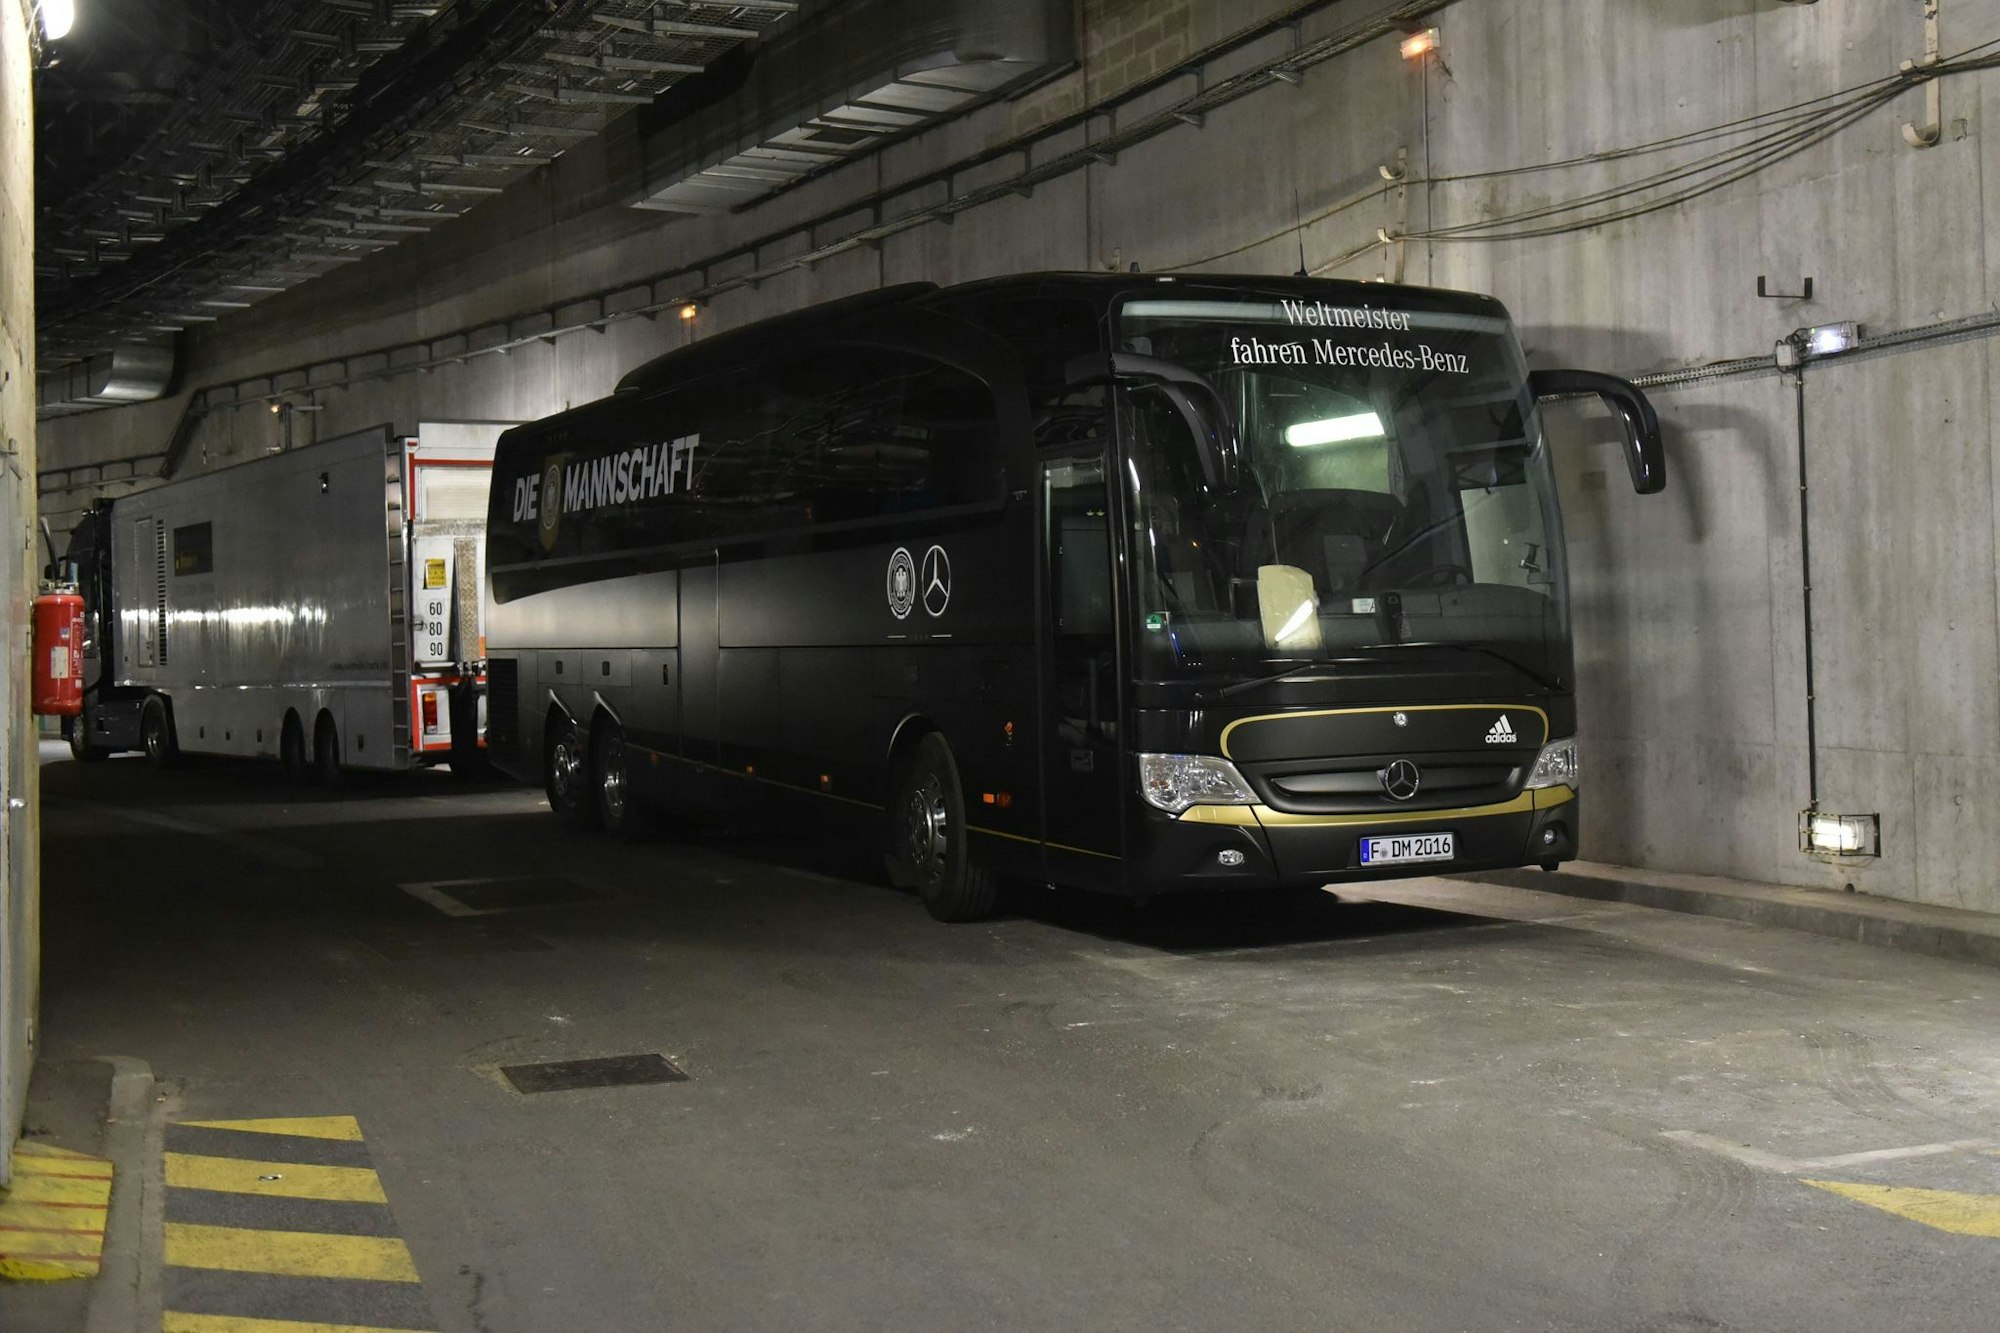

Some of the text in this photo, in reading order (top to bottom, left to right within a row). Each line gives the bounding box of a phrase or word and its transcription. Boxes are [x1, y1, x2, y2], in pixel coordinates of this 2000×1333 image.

[1281, 299, 1410, 331] Weltmeister
[1231, 337, 1469, 374] fahren Mercedes-Benz
[513, 433, 700, 523] DIE MANNSCHAFT
[429, 602, 442, 615] 60
[429, 621, 442, 636] 80
[430, 642, 443, 656] 90
[1485, 732, 1517, 743] adidas
[1371, 841, 1380, 859] F
[1392, 839, 1411, 857] DM
[1415, 837, 1451, 856] 2016
